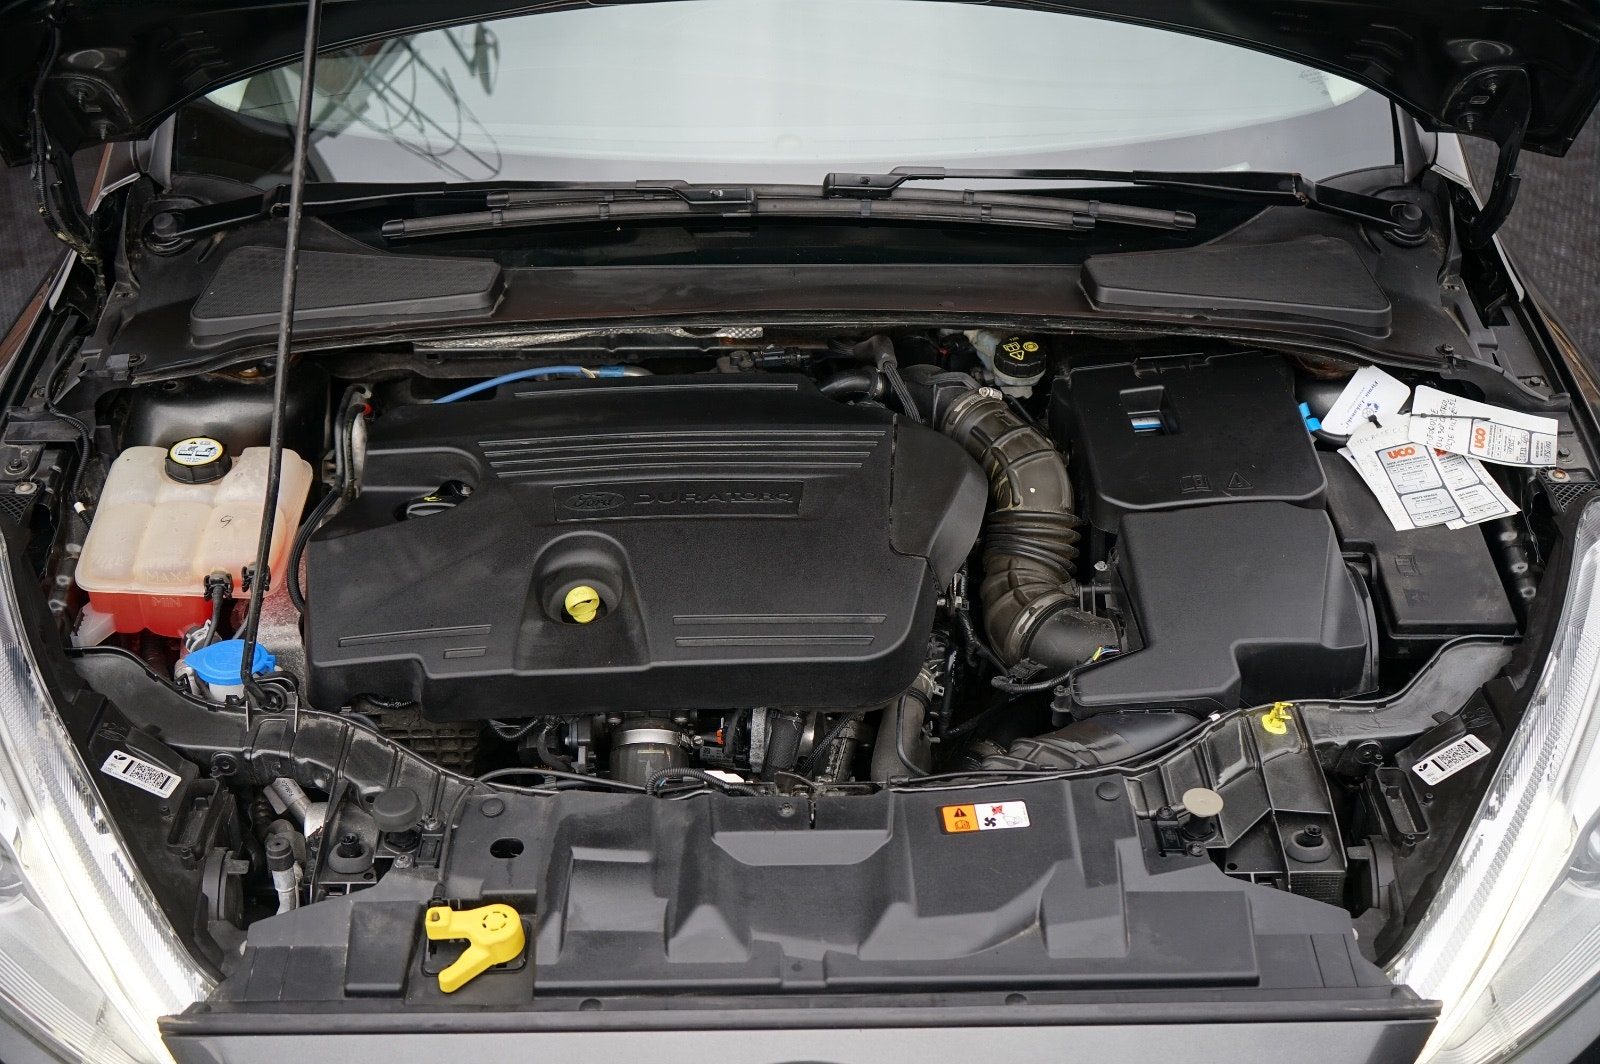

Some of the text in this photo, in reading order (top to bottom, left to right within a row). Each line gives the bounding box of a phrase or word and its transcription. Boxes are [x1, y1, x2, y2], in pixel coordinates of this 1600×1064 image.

[1473, 427, 1487, 449] UCO
[1387, 447, 1416, 459] UCO
[573, 492, 794, 507] Ford DURATORQ
